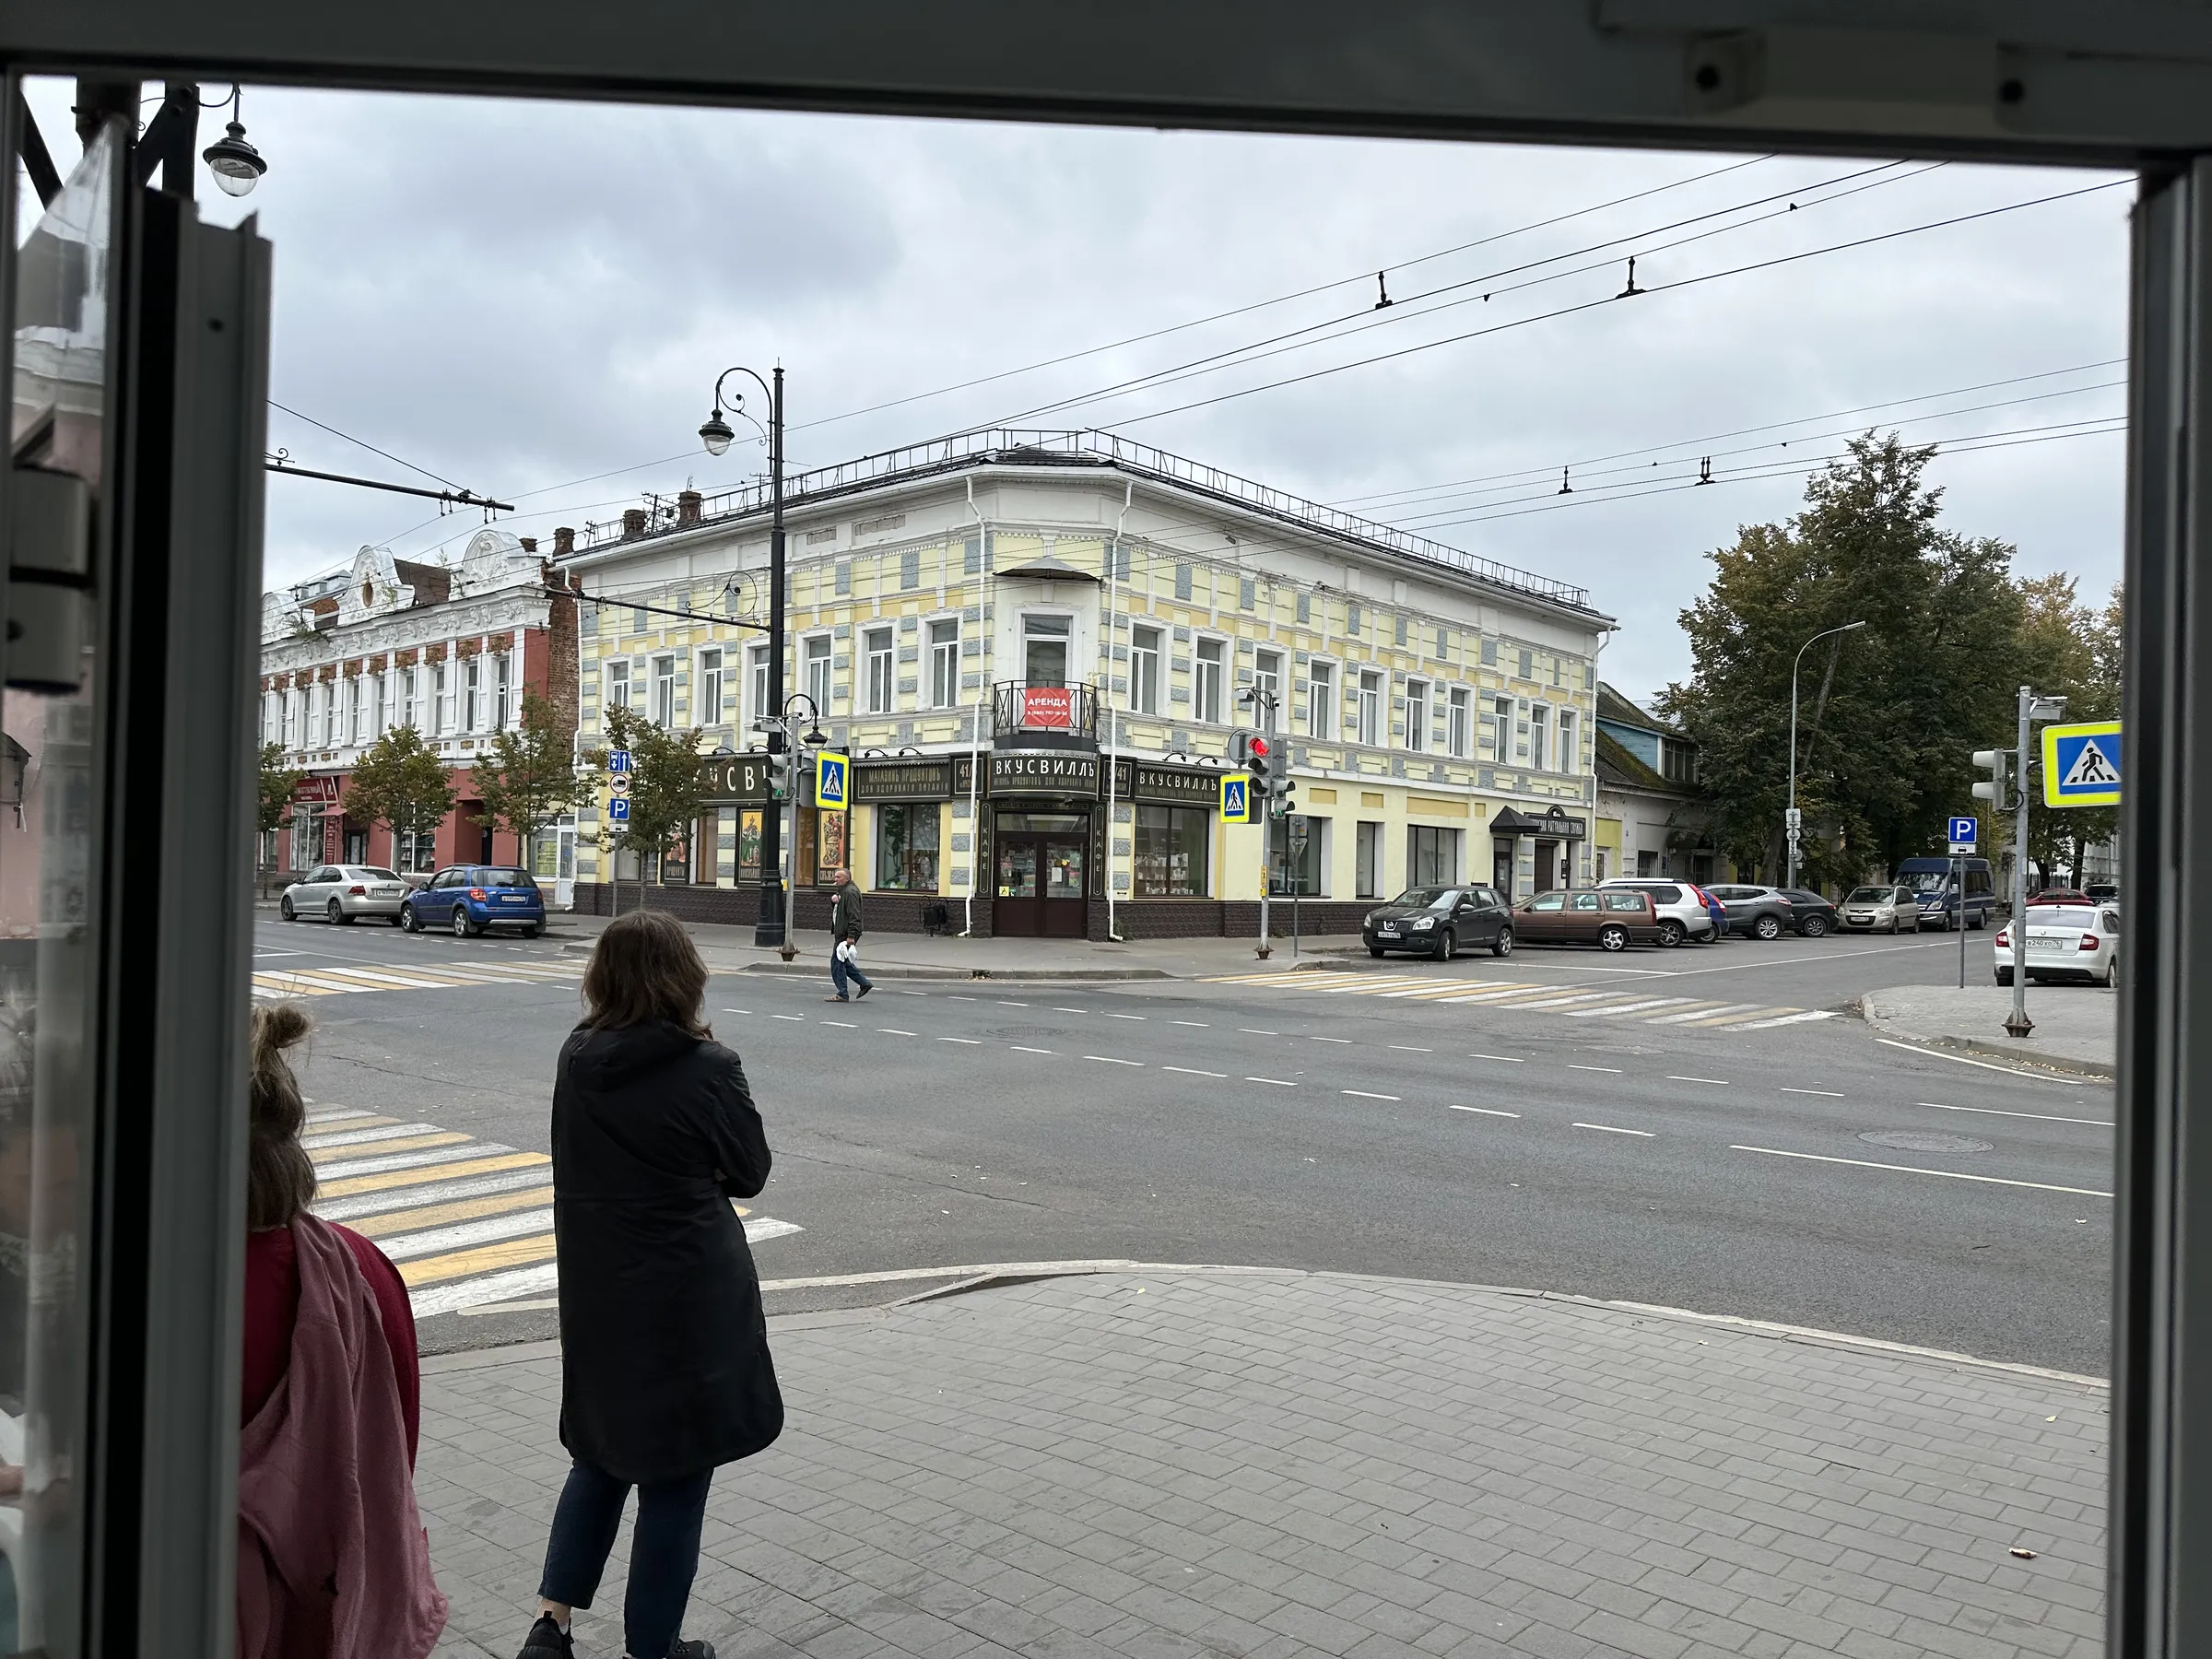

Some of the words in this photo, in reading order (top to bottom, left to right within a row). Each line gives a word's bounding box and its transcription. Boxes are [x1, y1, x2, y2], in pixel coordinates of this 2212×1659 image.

[1028, 698, 1067, 707] АРЕНДА
[995, 759, 1095, 777] ВКУСВИЛЛЪ
[1139, 771, 1217, 791] ВКУСВИЛЛЪ
[1956, 820, 1971, 840] P
